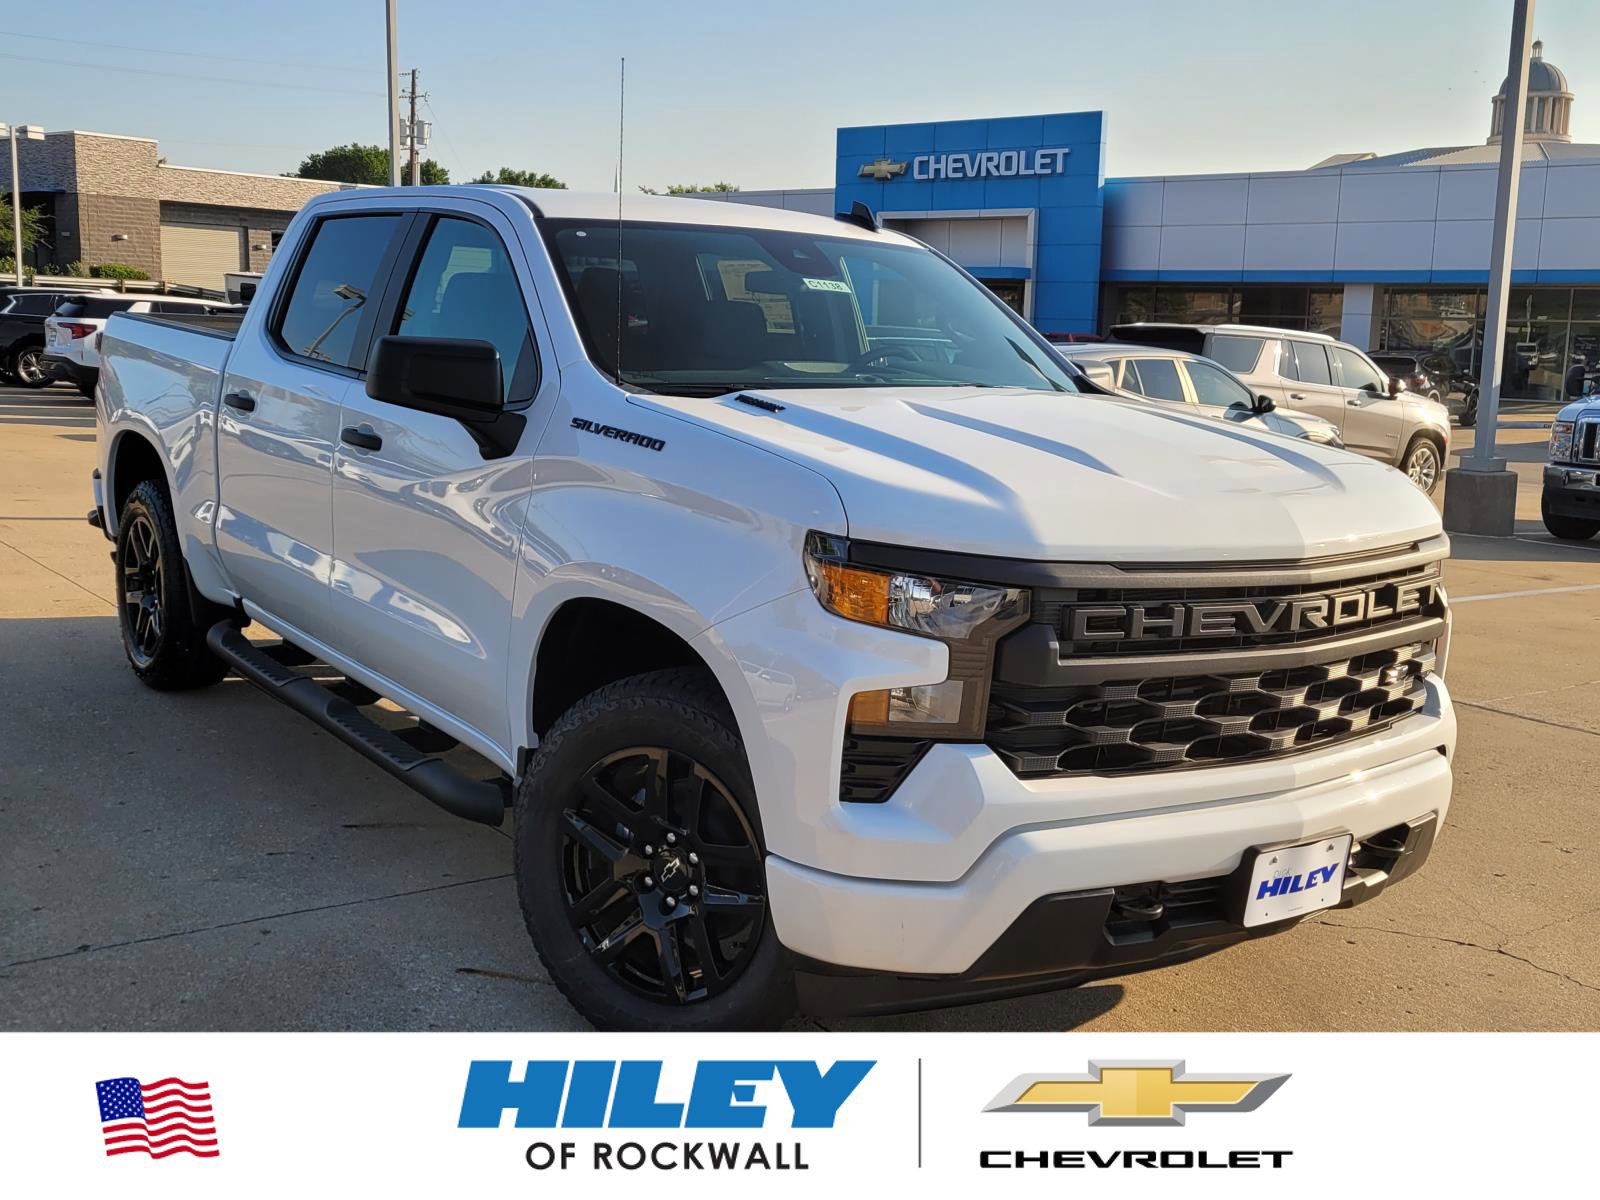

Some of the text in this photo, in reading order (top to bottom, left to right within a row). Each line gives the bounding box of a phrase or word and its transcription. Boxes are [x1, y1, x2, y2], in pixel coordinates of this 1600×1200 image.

[913, 148, 1069, 180] CHEVROLET
[808, 279, 844, 291] C1138
[570, 417, 666, 452] SILVERADO
[1256, 863, 1339, 900] HILEY
